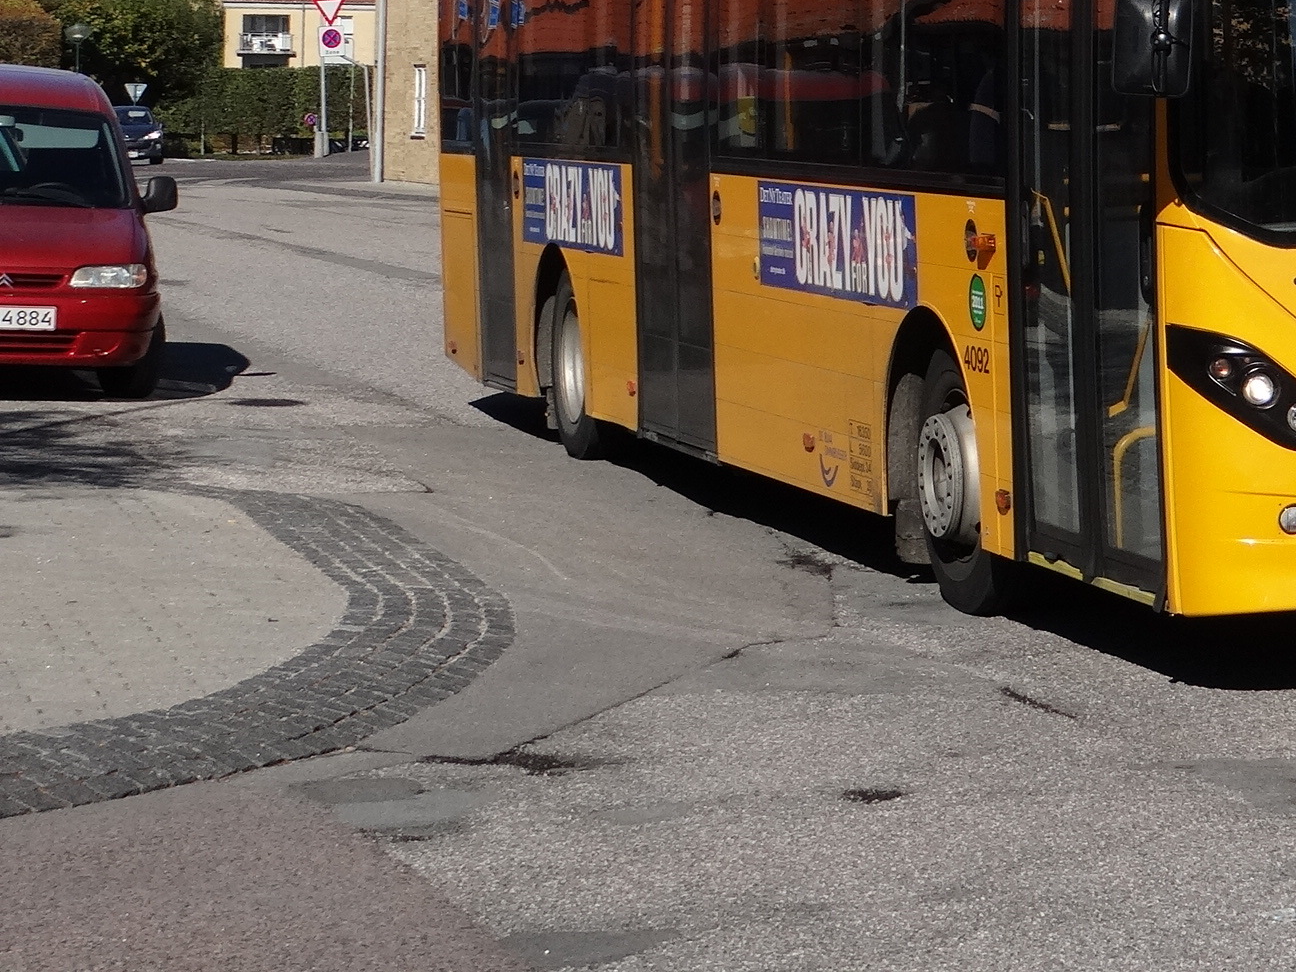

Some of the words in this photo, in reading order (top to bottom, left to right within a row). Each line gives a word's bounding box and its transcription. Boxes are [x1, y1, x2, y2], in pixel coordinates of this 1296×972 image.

[794, 188, 852, 292] CRAZY
[851, 260, 867, 294] FOR
[862, 196, 904, 303] YOU
[964, 345, 990, 375] 4092
